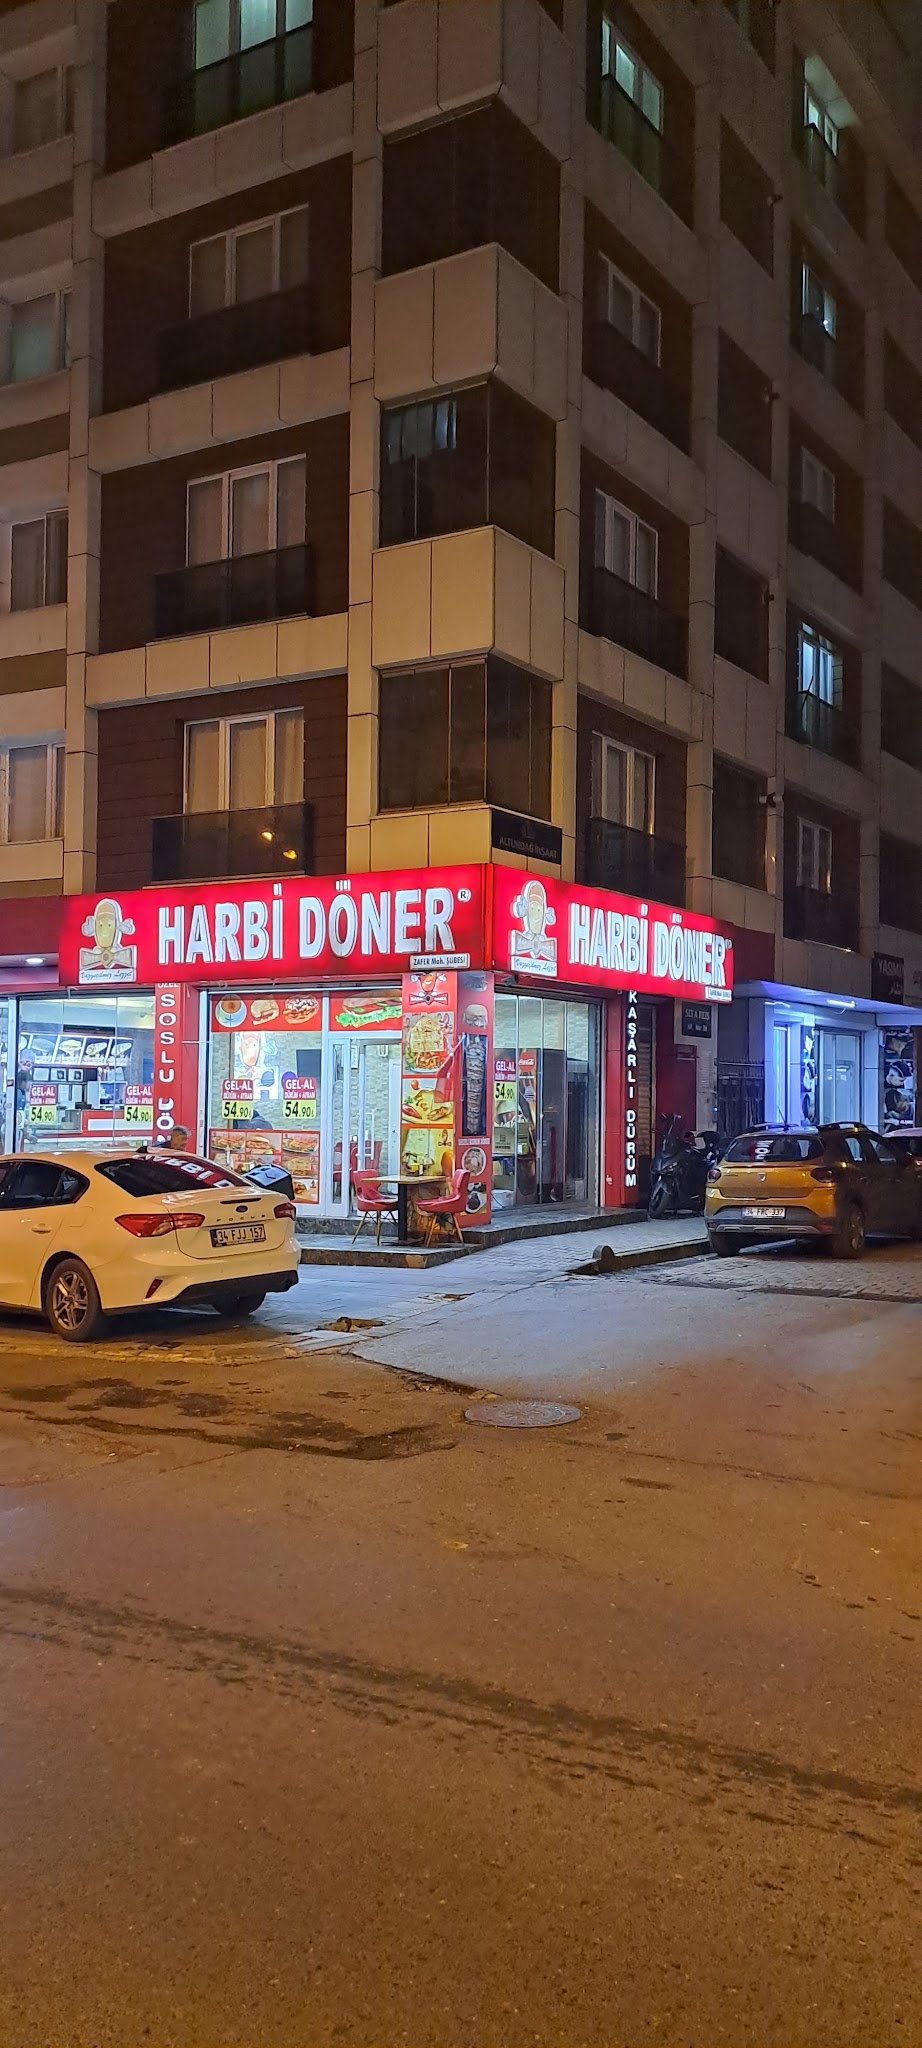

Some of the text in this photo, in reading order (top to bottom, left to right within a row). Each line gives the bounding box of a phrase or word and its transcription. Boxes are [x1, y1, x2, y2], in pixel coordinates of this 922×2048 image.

[158, 883, 283, 965] HARBİ
[299, 879, 456, 959] DÖNER
[569, 902, 649, 975] HARBİ
[653, 912, 726, 987] DÖNER
[159, 993, 176, 1083] SOSLU
[495, 1060, 516, 1072] GEL-AL
[126, 1085, 152, 1096] GEL-AL
[224, 1080, 252, 1091] GEL-AL
[285, 1079, 314, 1089] GEL-AL
[625, 989, 638, 1188] KAŞARLI DÜRÜM
[31, 1087, 55, 1097] GEL-AL
[217, 1226, 263, 1242] 34 FJJ 157
